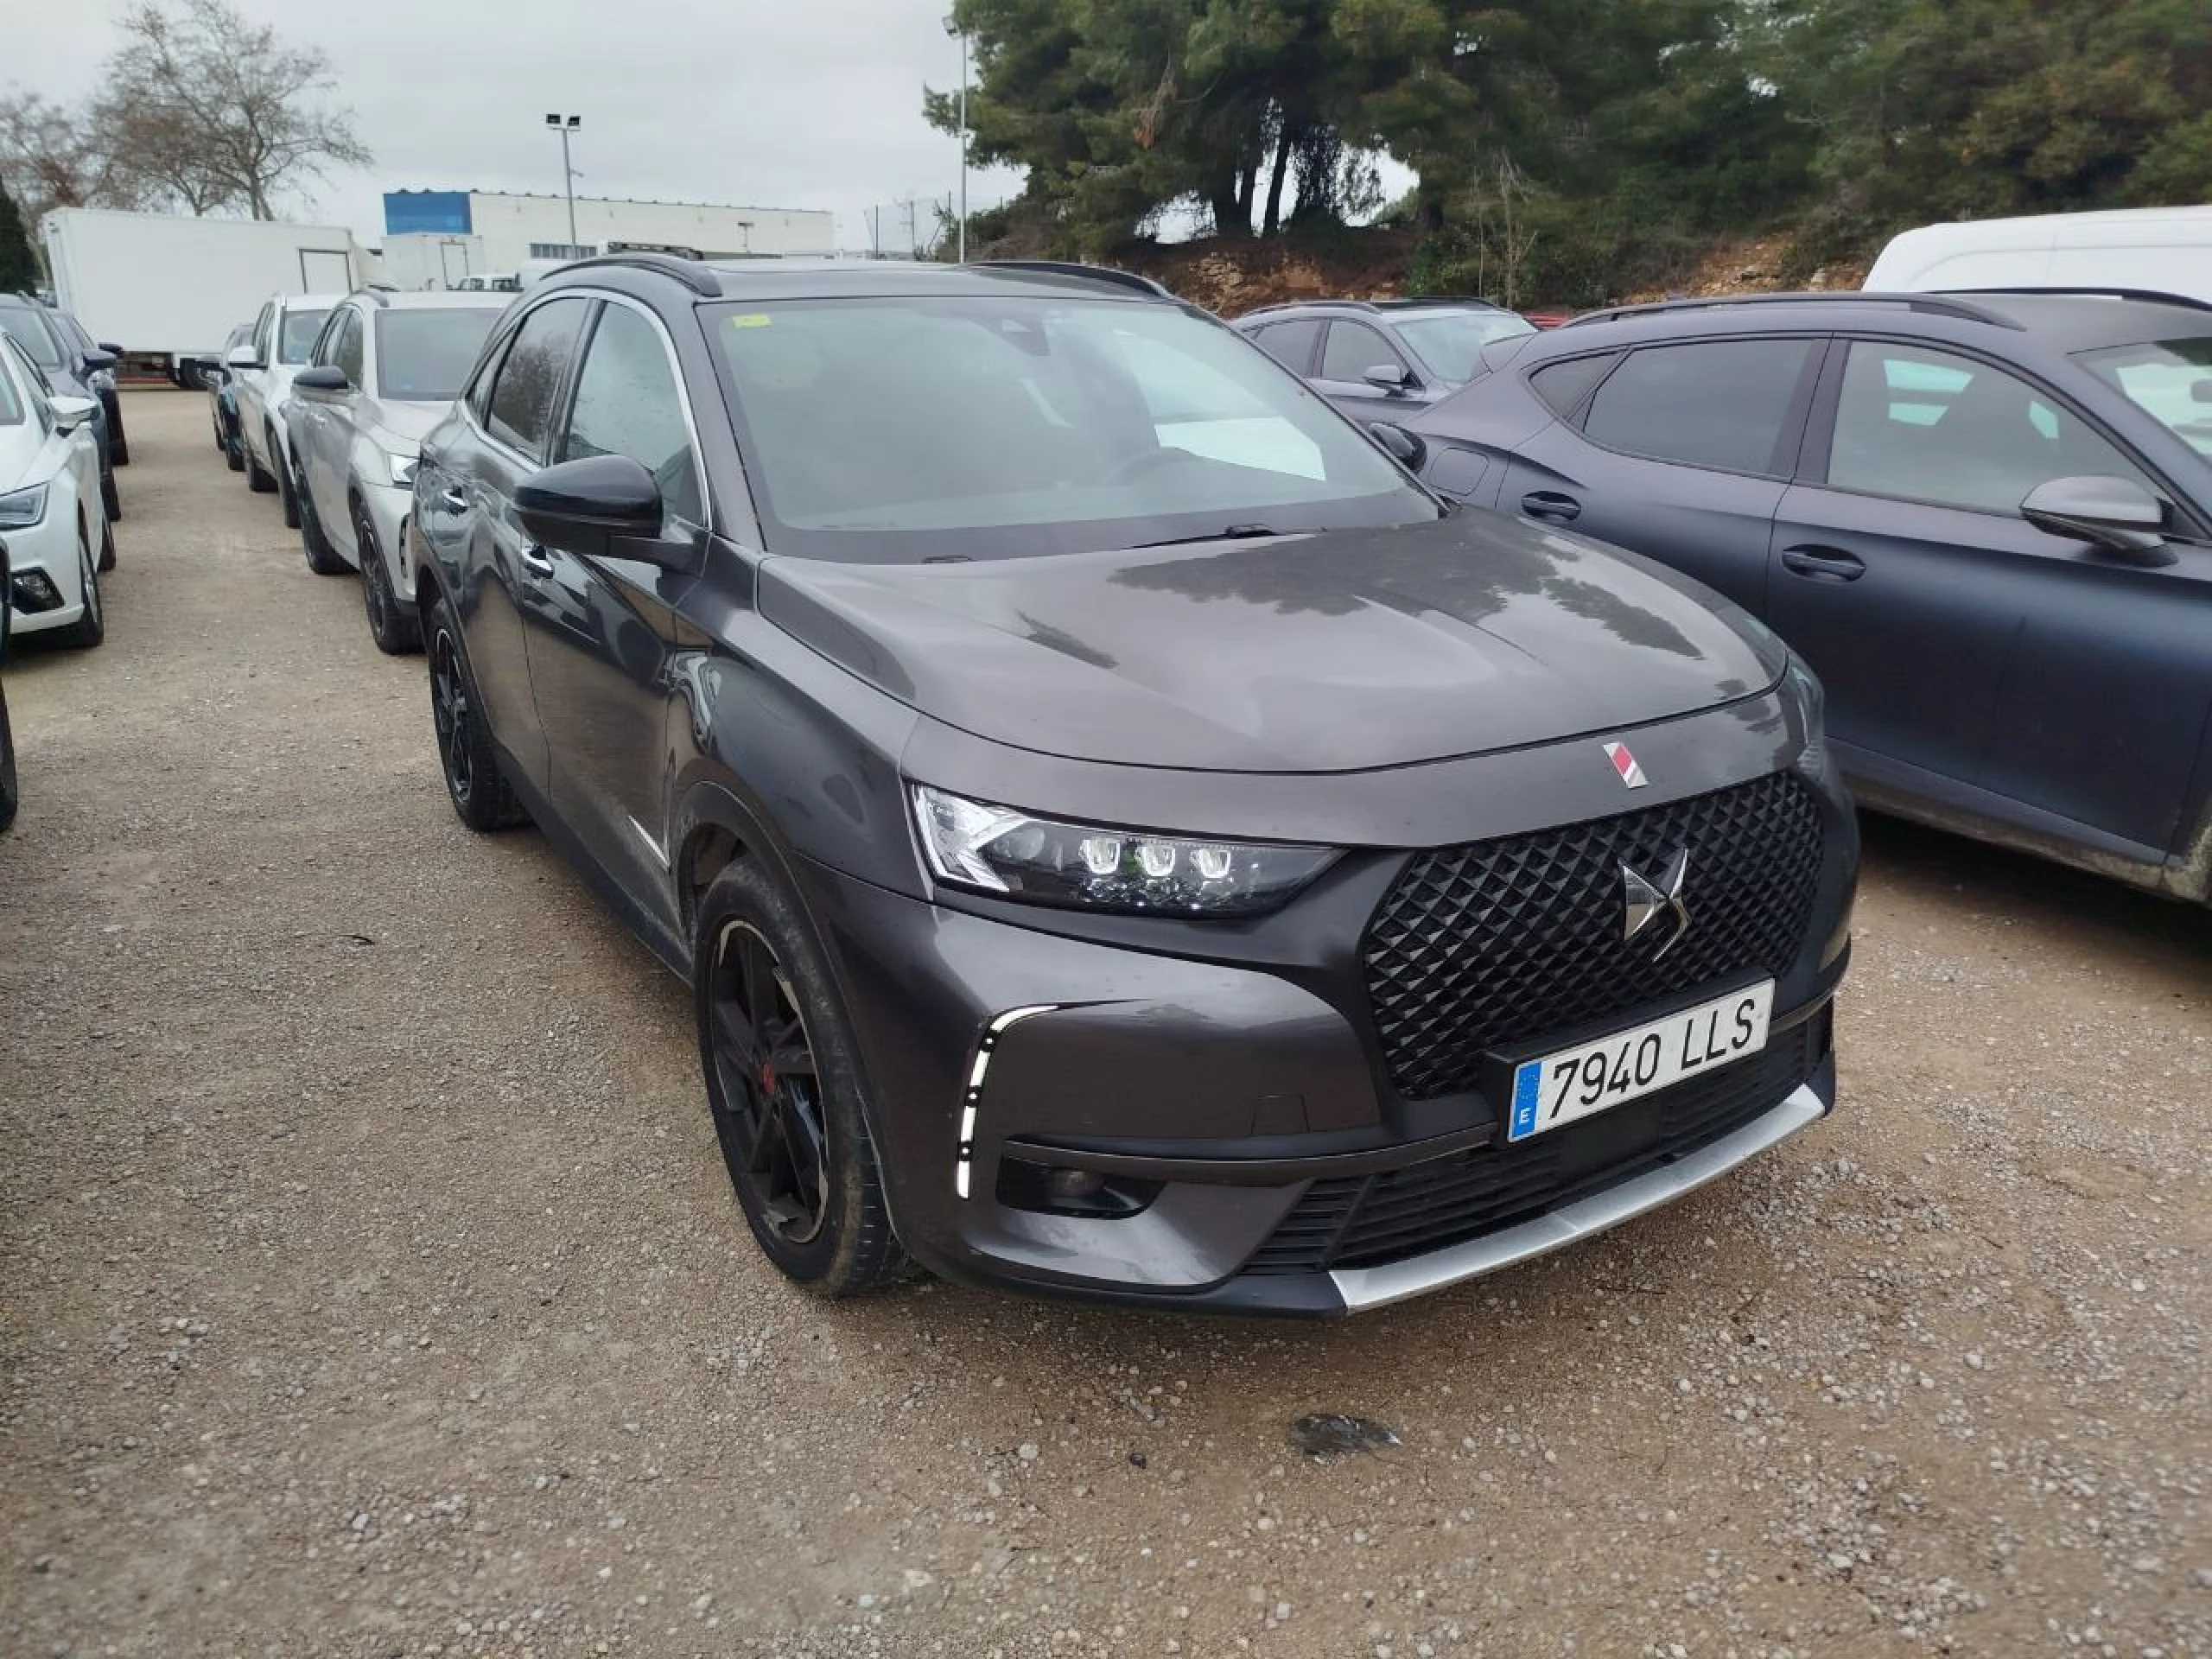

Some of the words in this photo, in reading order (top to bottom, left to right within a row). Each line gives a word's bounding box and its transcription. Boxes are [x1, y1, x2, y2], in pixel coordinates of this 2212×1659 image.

[1549, 1033, 1662, 1119] 7940
[1681, 998, 1755, 1071] LLS
[1519, 1107, 1532, 1125] E
